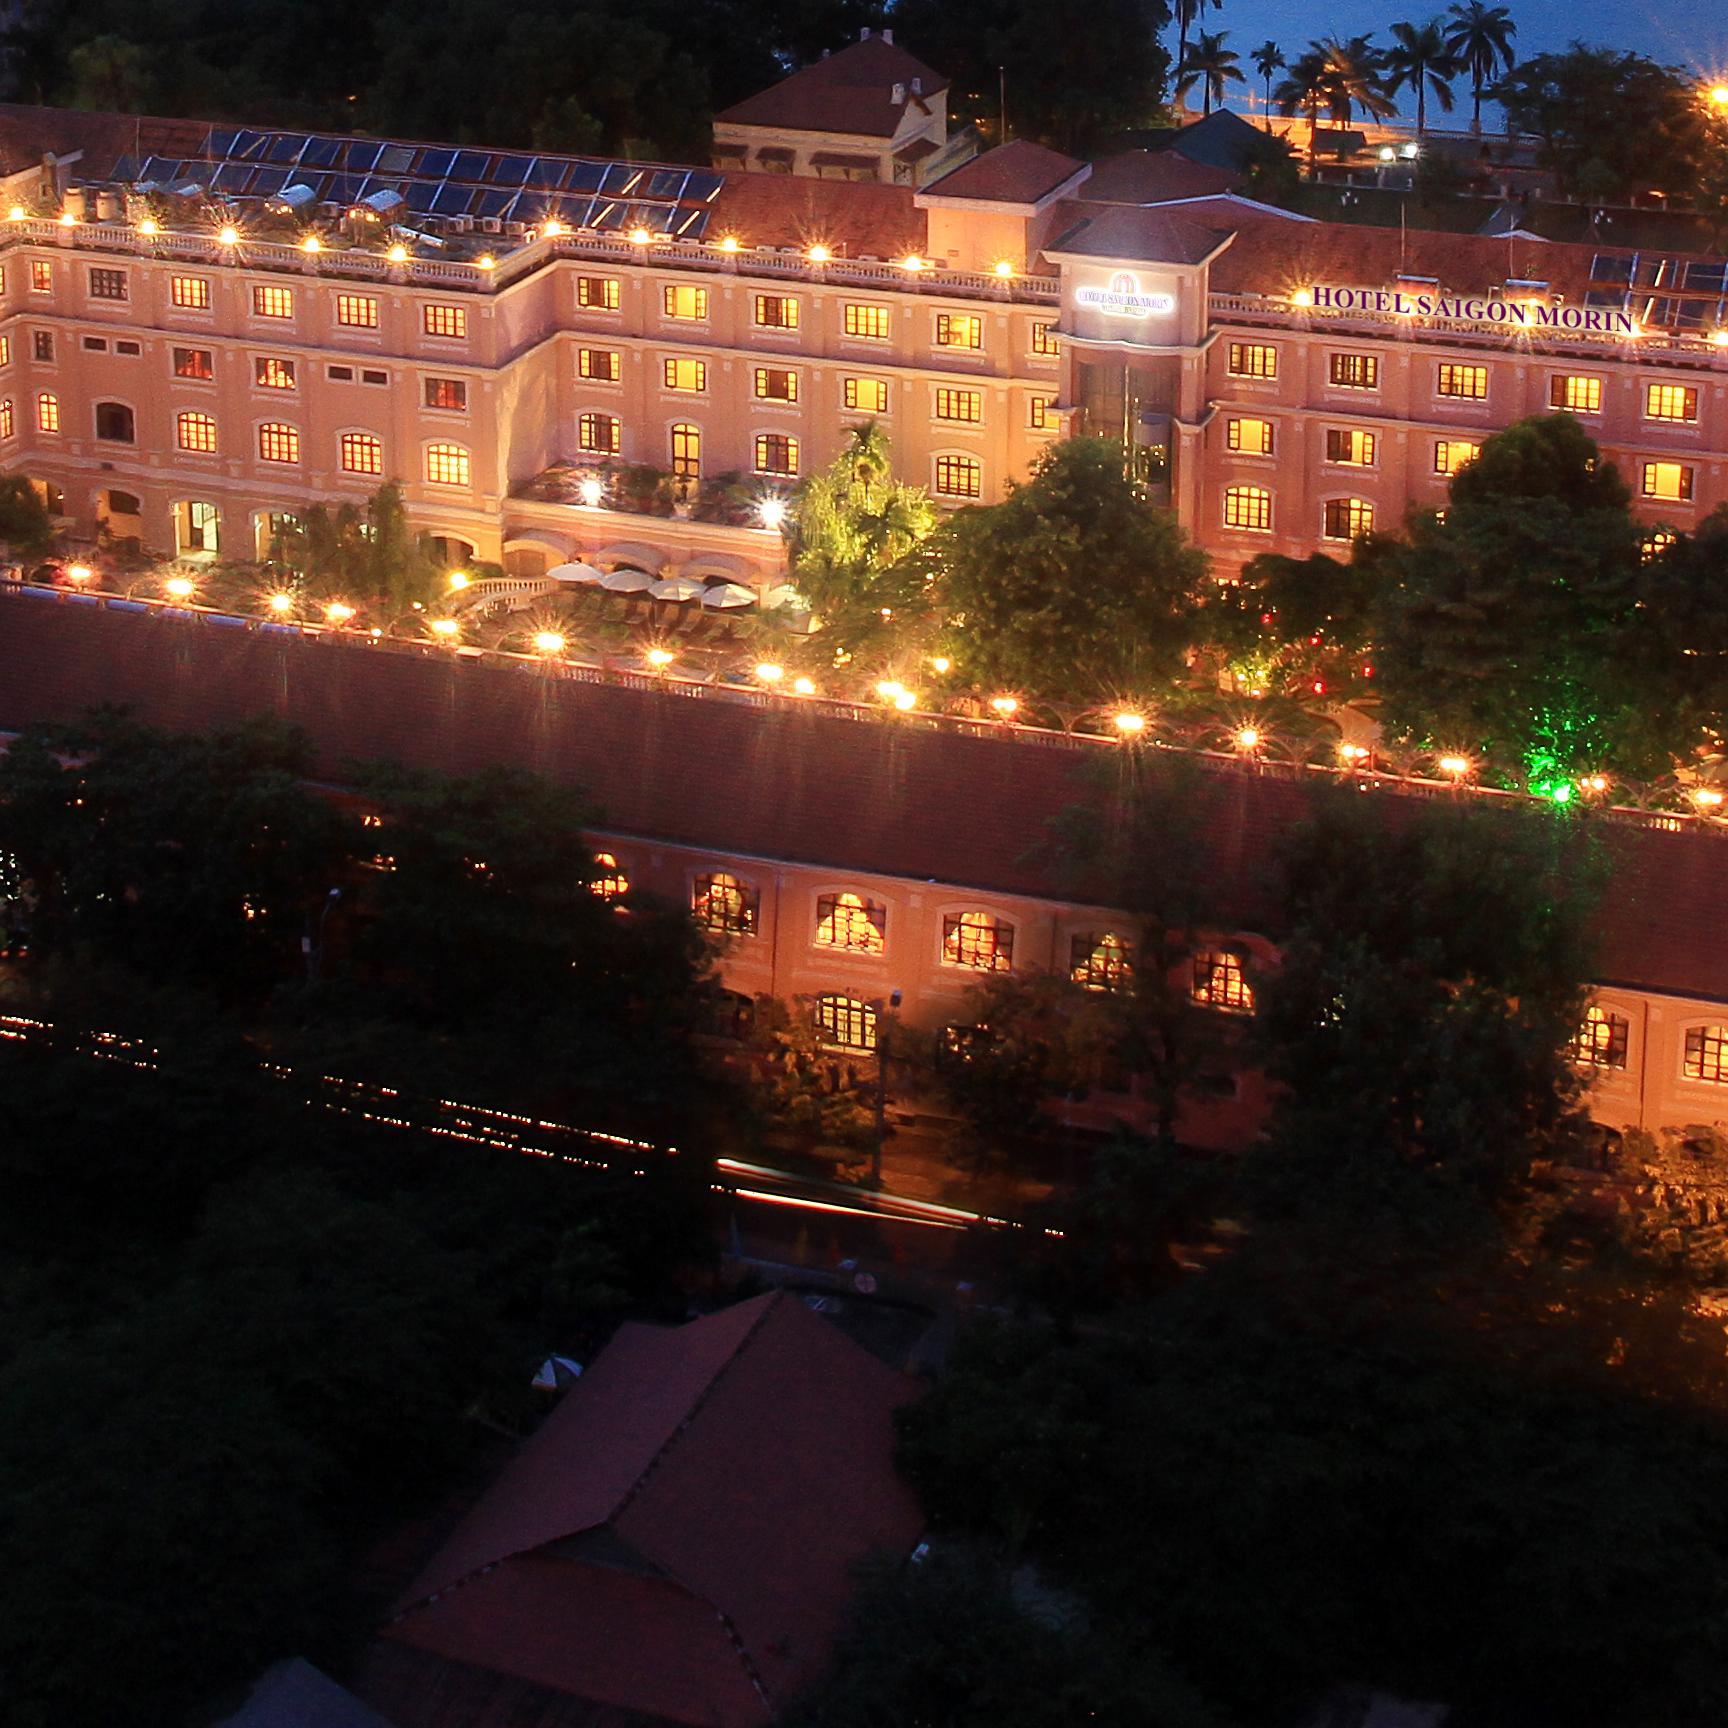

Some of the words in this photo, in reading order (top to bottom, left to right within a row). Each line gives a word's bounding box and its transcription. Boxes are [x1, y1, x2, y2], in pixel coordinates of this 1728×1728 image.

[1313, 286, 1410, 314] HOTEL
[1417, 295, 1526, 323] SAIGON
[1536, 305, 1633, 333] MORIN
